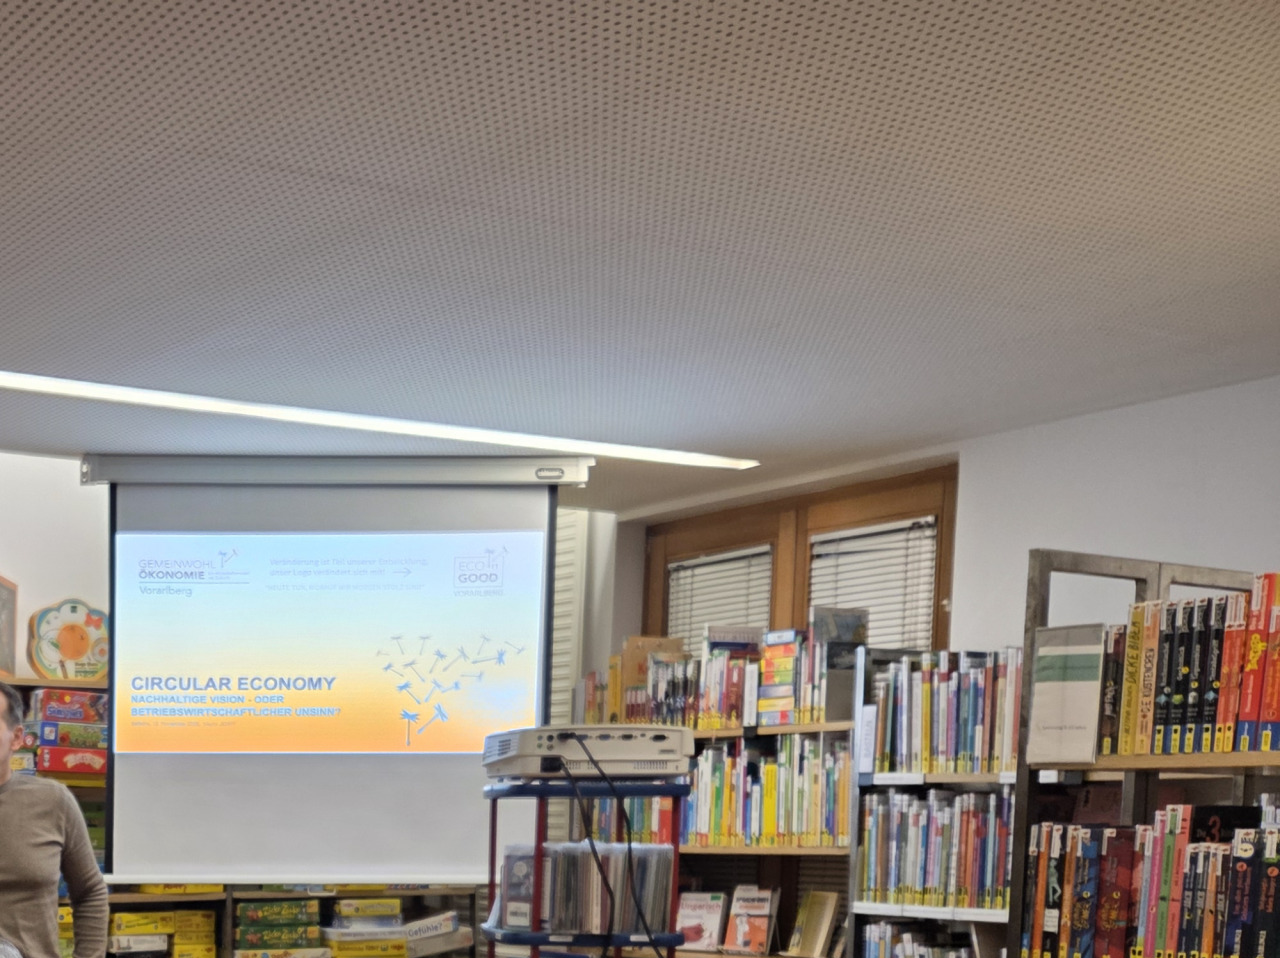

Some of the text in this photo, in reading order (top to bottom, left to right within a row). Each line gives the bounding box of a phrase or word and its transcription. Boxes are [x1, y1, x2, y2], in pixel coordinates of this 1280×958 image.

[138, 559, 217, 569] GEMEINWOHL
[138, 569, 206, 580] ÖKONOMIE
[458, 573, 498, 584] GOOD
[138, 585, 193, 598] Vorarlberg
[131, 676, 336, 691] CIRCULAR ECONOMY
[131, 695, 207, 703] NACHHALTIGE
[209, 695, 245, 703] VISION
[254, 695, 285, 703] ODER
[131, 707, 341, 717] BETRIEBSWIRTSCHAFTLICHER UNSINN?
[408, 922, 443, 937] Gefühle?
